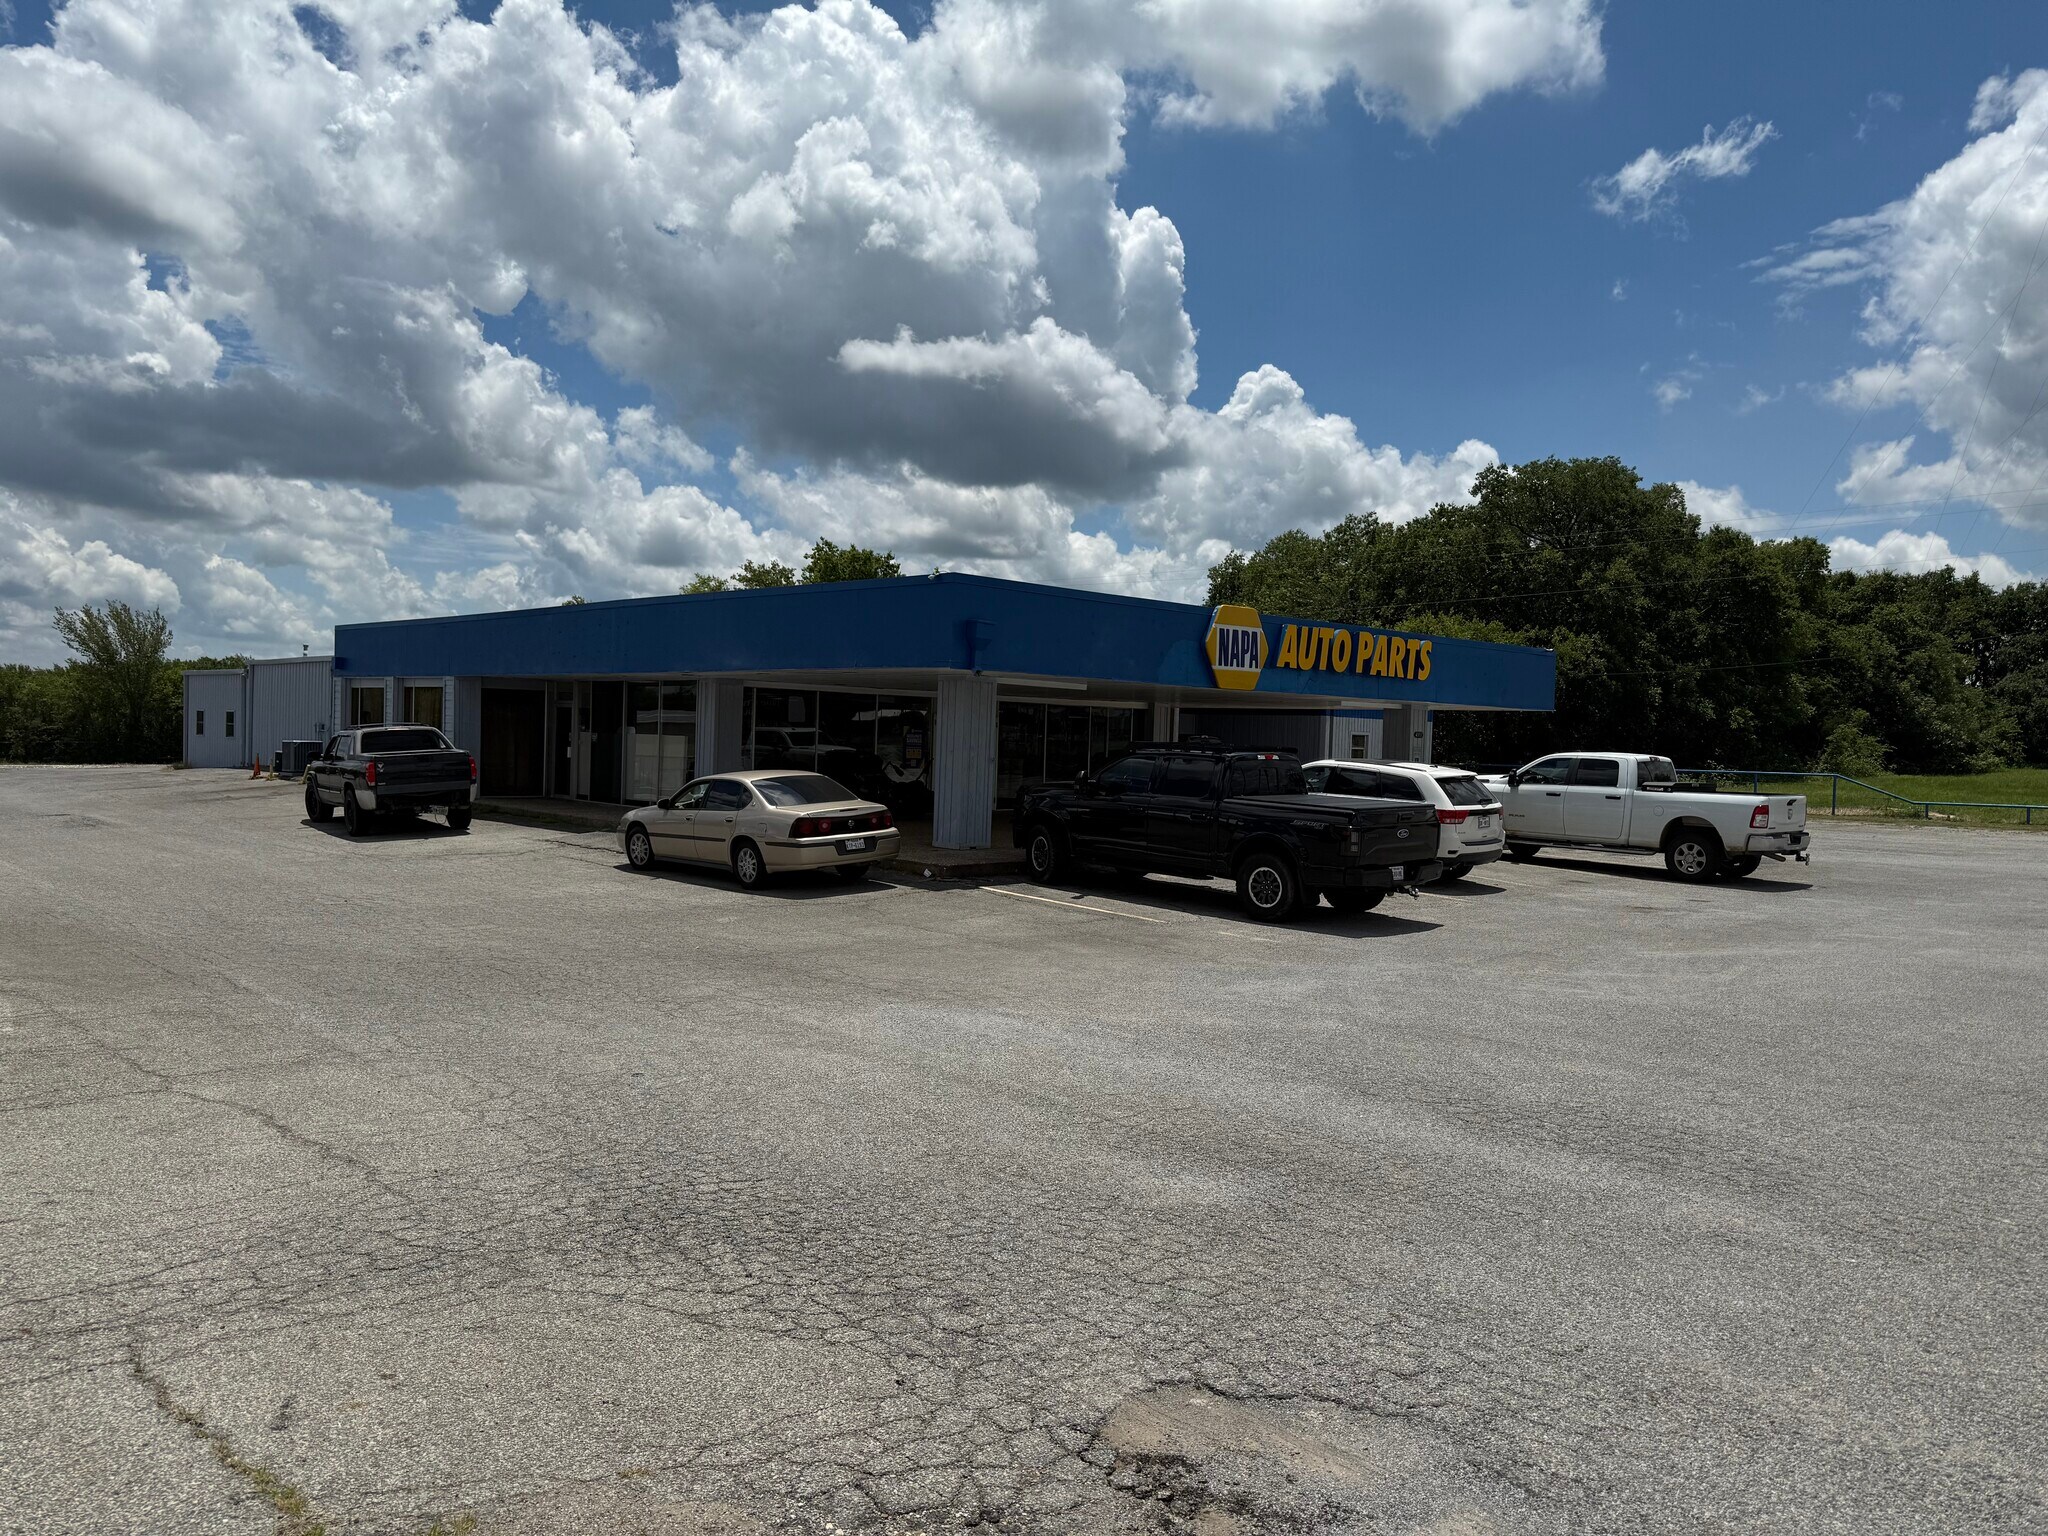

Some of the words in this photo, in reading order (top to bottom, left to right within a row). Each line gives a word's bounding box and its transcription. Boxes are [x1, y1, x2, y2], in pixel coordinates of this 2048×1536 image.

[1218, 628, 1259, 669] NAPA
[1276, 624, 1352, 673] AUTO
[1355, 631, 1433, 681] PARTS
